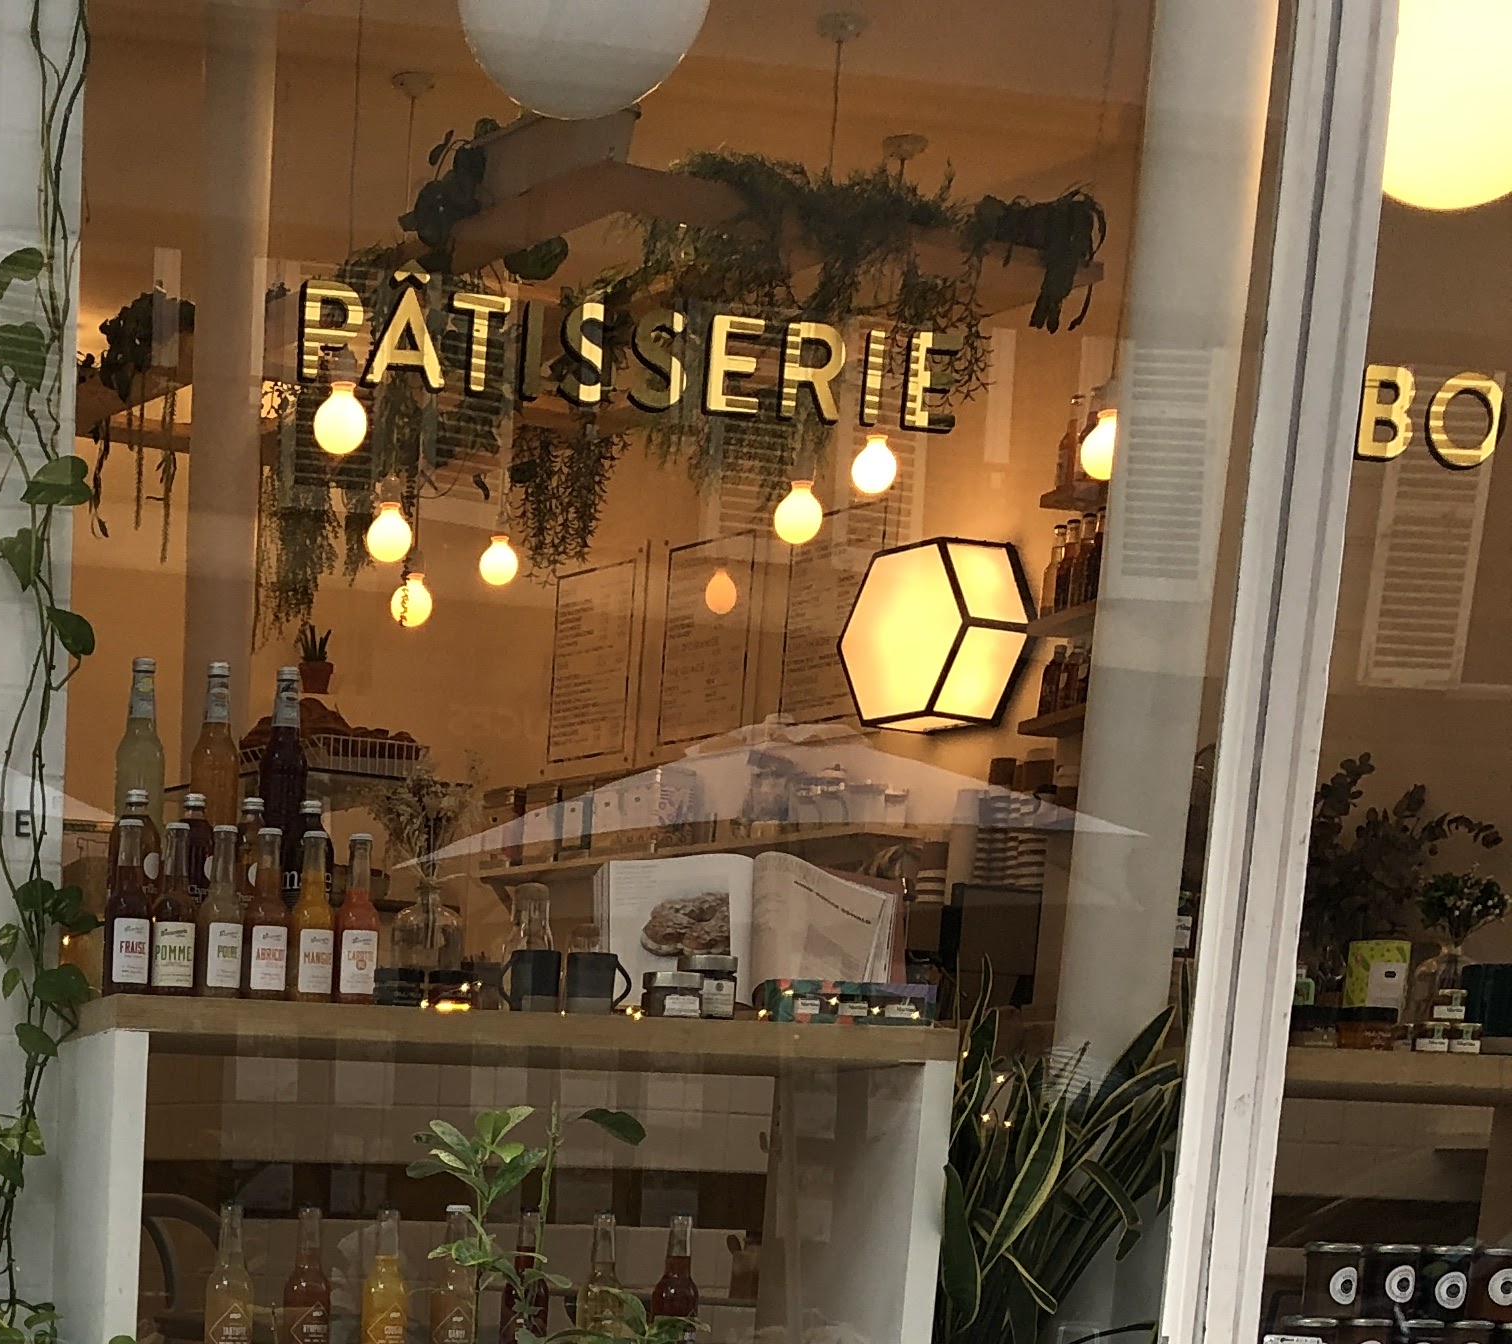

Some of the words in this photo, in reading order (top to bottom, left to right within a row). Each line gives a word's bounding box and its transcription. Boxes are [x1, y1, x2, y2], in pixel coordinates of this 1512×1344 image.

[297, 259, 963, 433] PÂTISSERIE
[1355, 363, 1507, 470] BO
[120, 941, 146, 955] FRAISE
[155, 945, 192, 961] POMME
